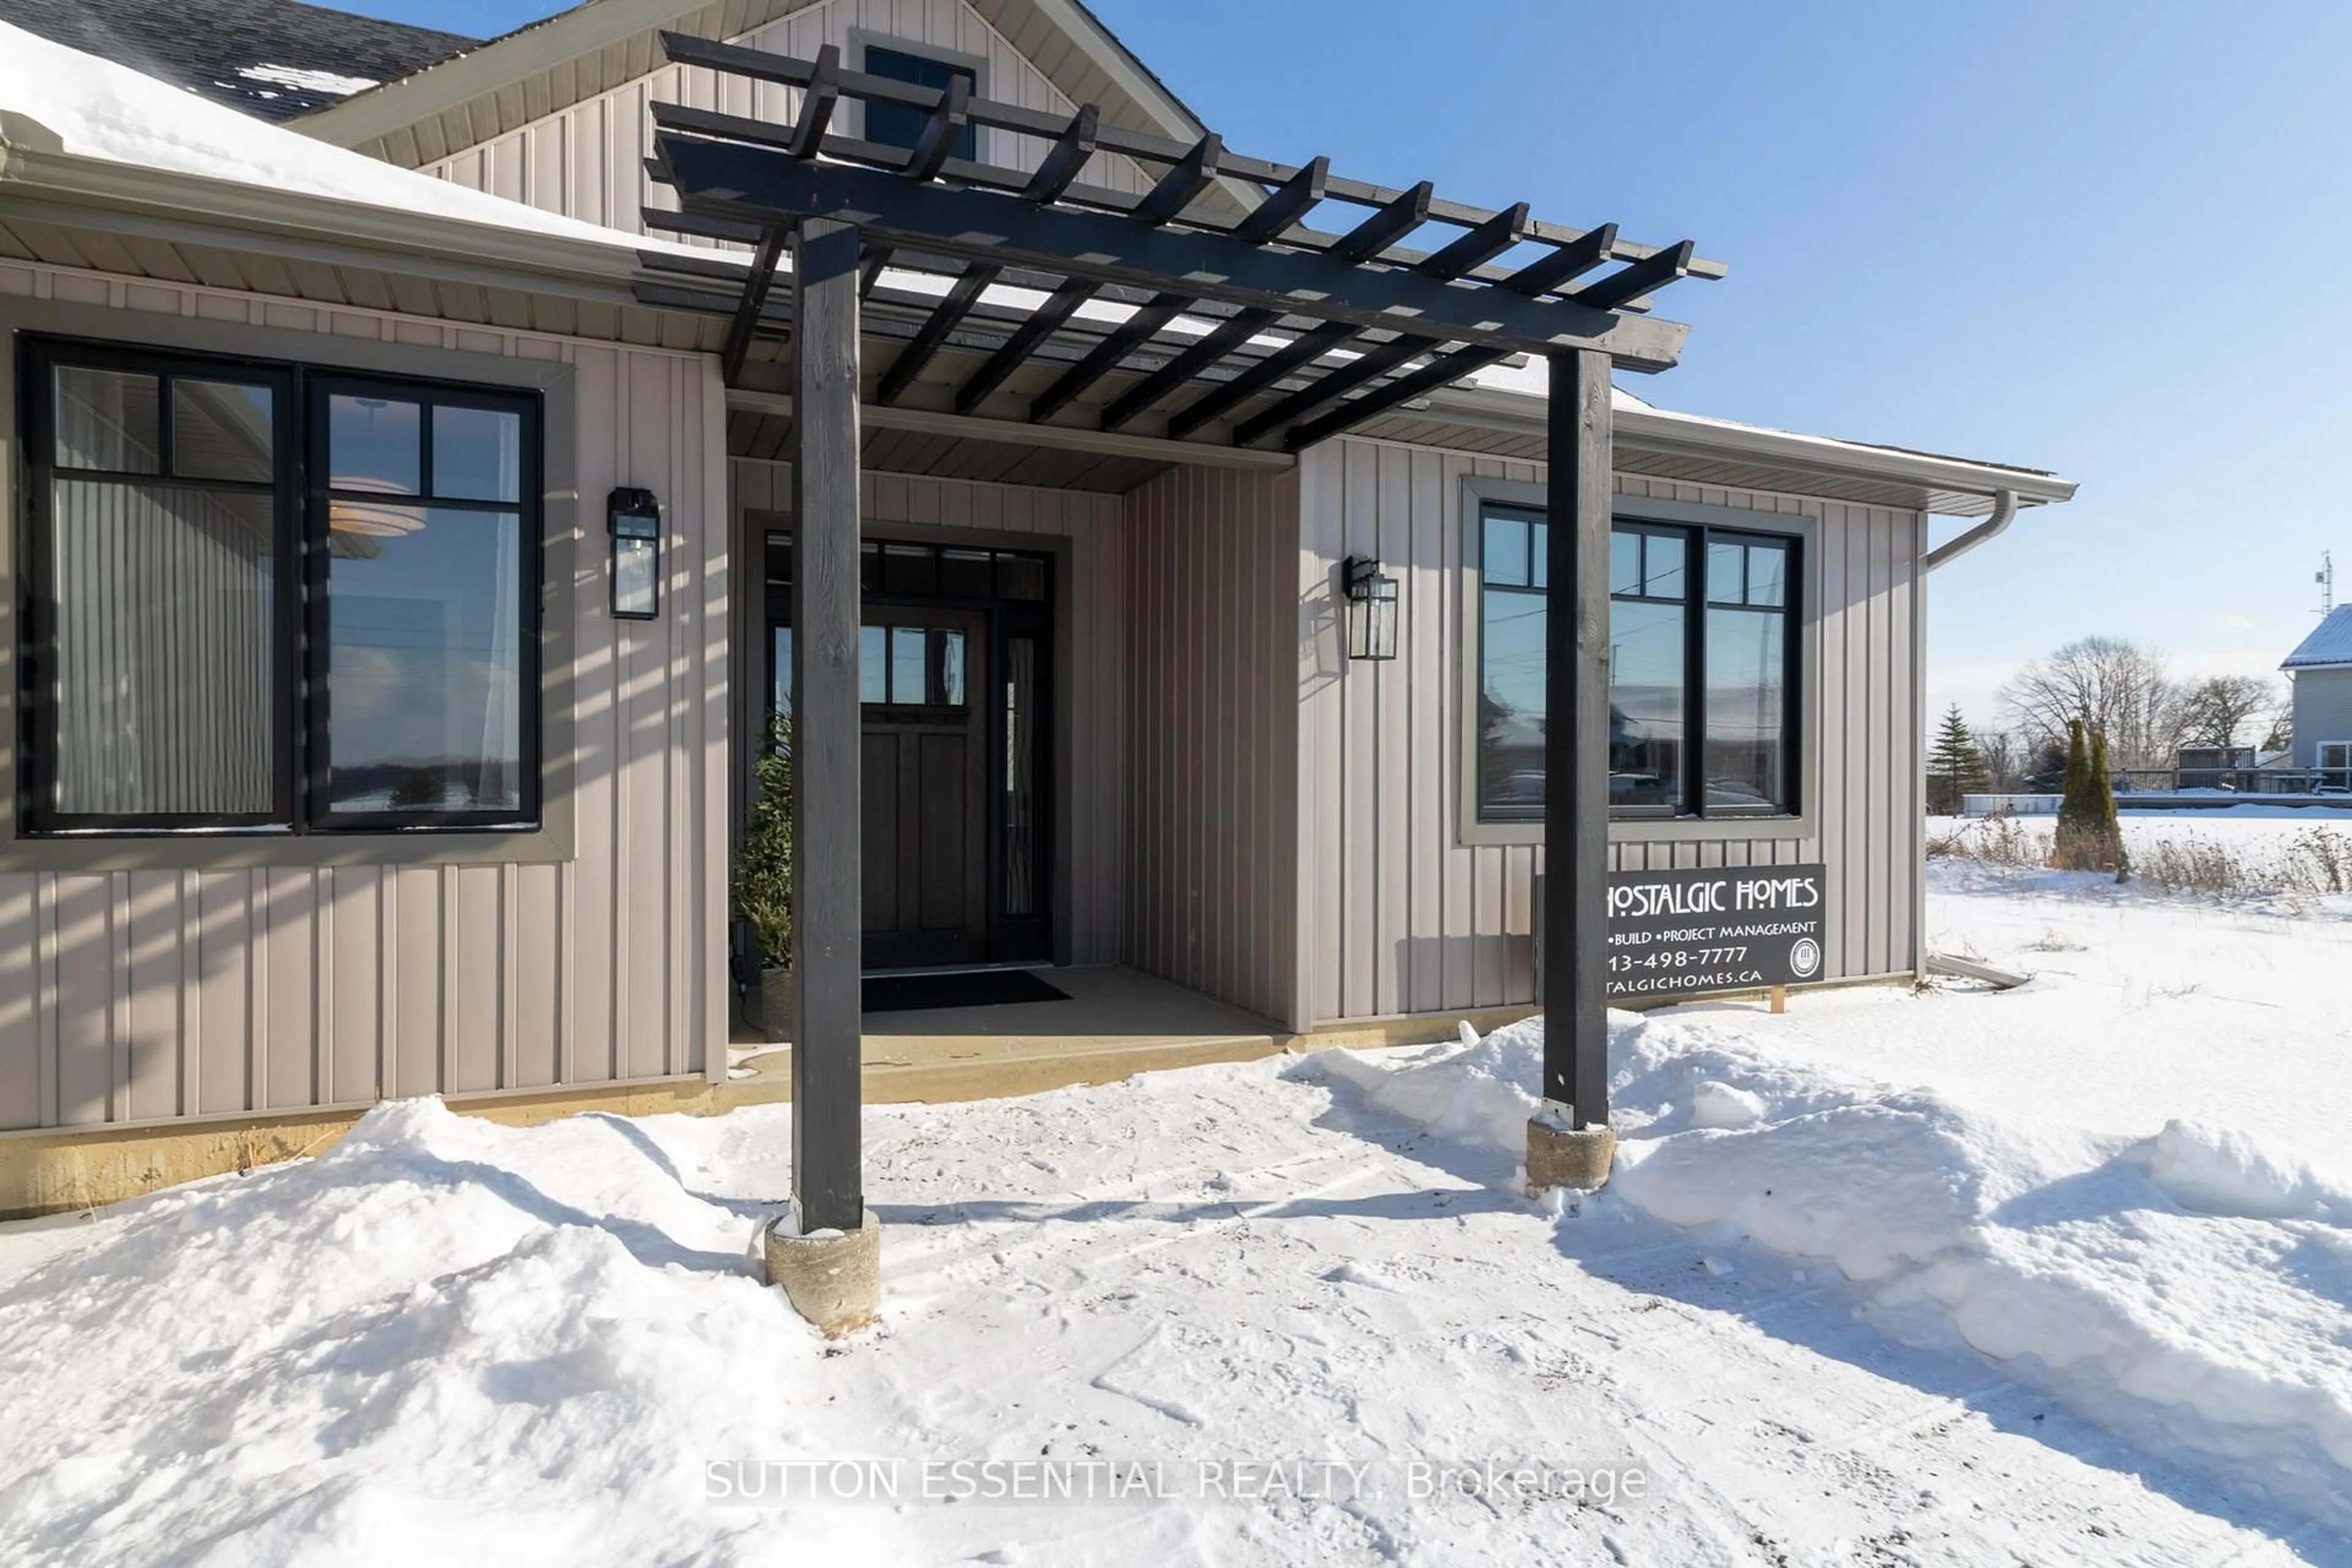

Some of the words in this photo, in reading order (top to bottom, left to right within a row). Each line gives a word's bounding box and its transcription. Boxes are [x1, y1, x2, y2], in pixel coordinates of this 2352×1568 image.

[1736, 878, 1819, 910] HOMES
[1615, 932, 1652, 945] BUILD
[1663, 927, 1715, 942] PROJECT
[1720, 921, 1817, 938] MANAGEMENT
[1608, 947, 1747, 971] 13-498-7777
[1606, 971, 1762, 993] TALGICHOMES.CA
